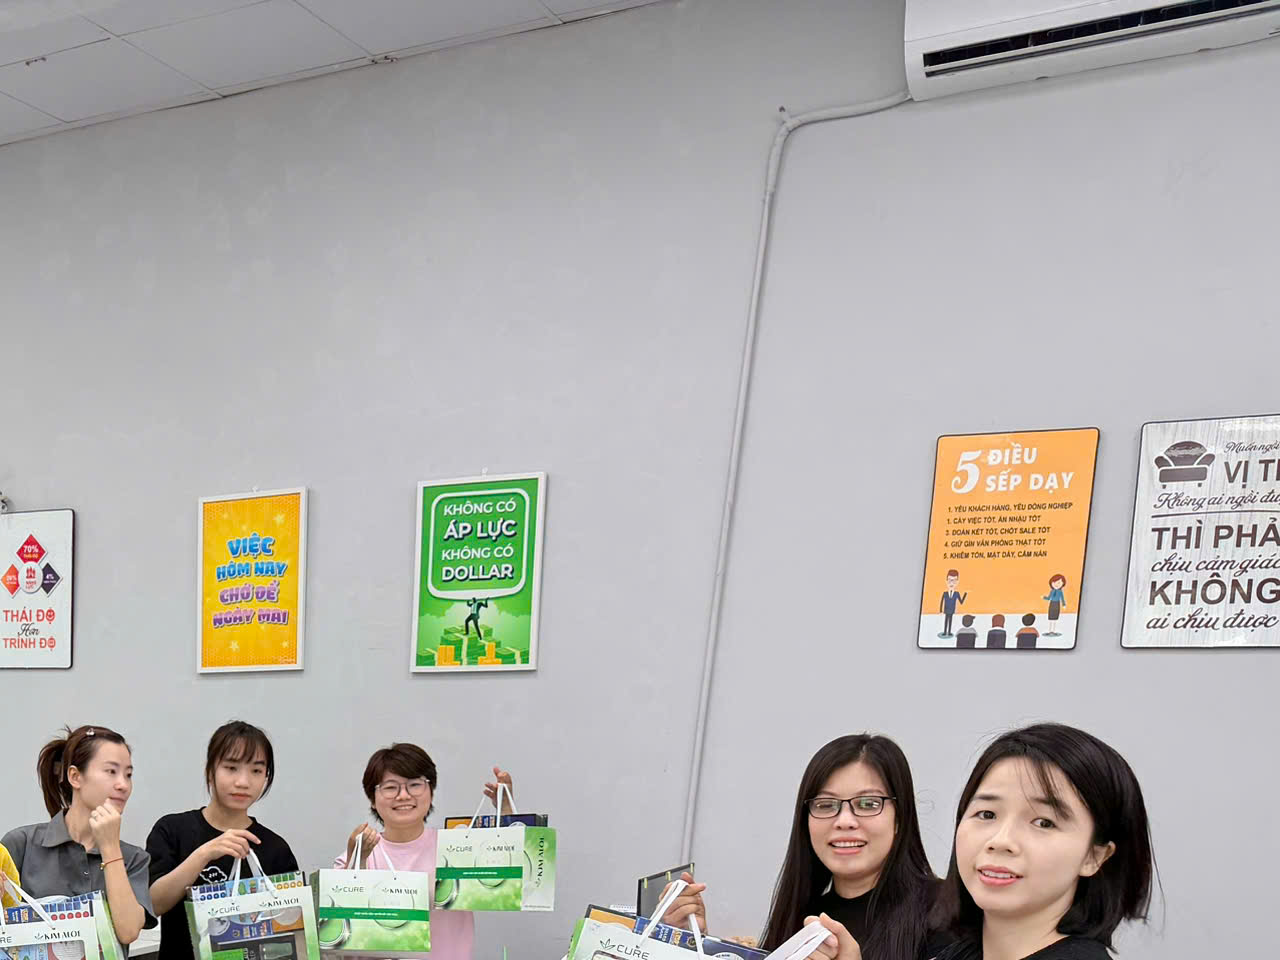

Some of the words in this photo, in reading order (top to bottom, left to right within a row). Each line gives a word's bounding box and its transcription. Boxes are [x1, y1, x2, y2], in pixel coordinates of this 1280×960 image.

[987, 442, 1038, 466] ĐIỀU
[951, 450, 982, 494] 5
[985, 468, 1023, 493] SẾP
[1029, 471, 1075, 494] DẠY
[1224, 460, 1249, 489] VỊ
[1258, 459, 1280, 482] T
[444, 500, 493, 516] KHÔNG
[496, 498, 516, 513] CÓ
[1153, 492, 1206, 511] Không
[1208, 493, 1224, 505] ai
[1225, 490, 1259, 509] ngồi
[444, 519, 473, 541] ÁP
[477, 517, 518, 541] LỰC
[1019, 526, 1036, 534] SALE
[1151, 519, 1204, 550] THÌ
[227, 532, 275, 559] VIỆC
[442, 545, 491, 560] KHÔNG
[493, 543, 514, 558] CÓ
[216, 560, 251, 581] HÔM
[254, 560, 288, 578] NAY
[442, 563, 515, 582] DOLLAR
[1151, 552, 1192, 575] chịu
[1195, 556, 1240, 571] cảm
[219, 582, 253, 605] CHỚ
[255, 580, 280, 603] ĐỂ
[1149, 572, 1280, 606] KHÔNG
[2, 606, 32, 622] THÁI
[36, 607, 56, 625] ĐỘ
[212, 607, 255, 628] NGÀY
[257, 609, 289, 625] MAI
[1146, 613, 1170, 629] ai
[1173, 608, 1220, 633] chịu
[1223, 609, 1279, 632] được
[2, 635, 36, 649] TRÌNH
[39, 635, 56, 651] ĐỘ
[219, 905, 240, 914] CURE
[615, 943, 651, 960] CURE
